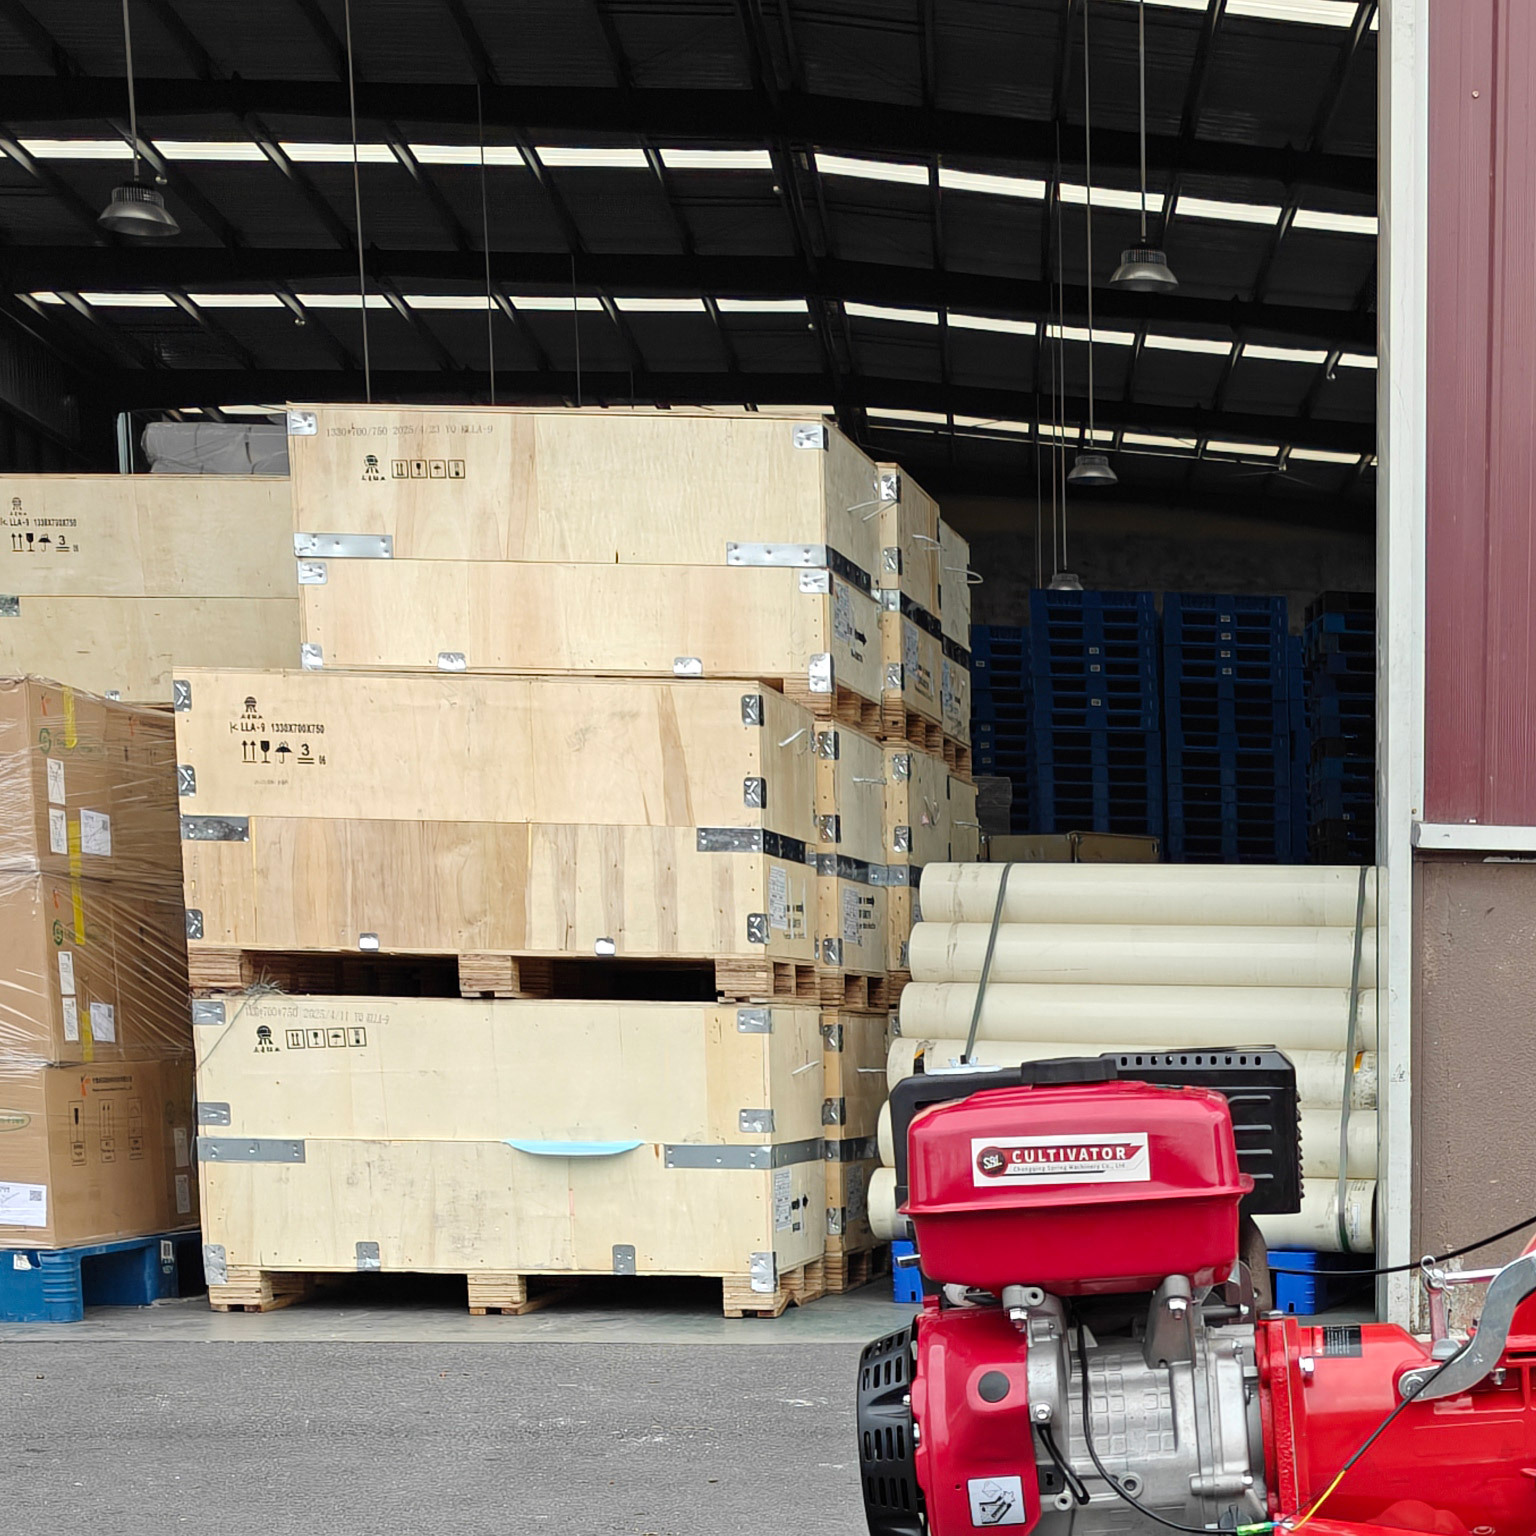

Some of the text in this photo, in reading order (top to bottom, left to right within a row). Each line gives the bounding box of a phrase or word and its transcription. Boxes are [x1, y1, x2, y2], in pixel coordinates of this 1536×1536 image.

[58, 535, 66, 545] 3
[301, 743, 310, 756] 3
[1012, 1146, 1127, 1163] CULTIVATOR
